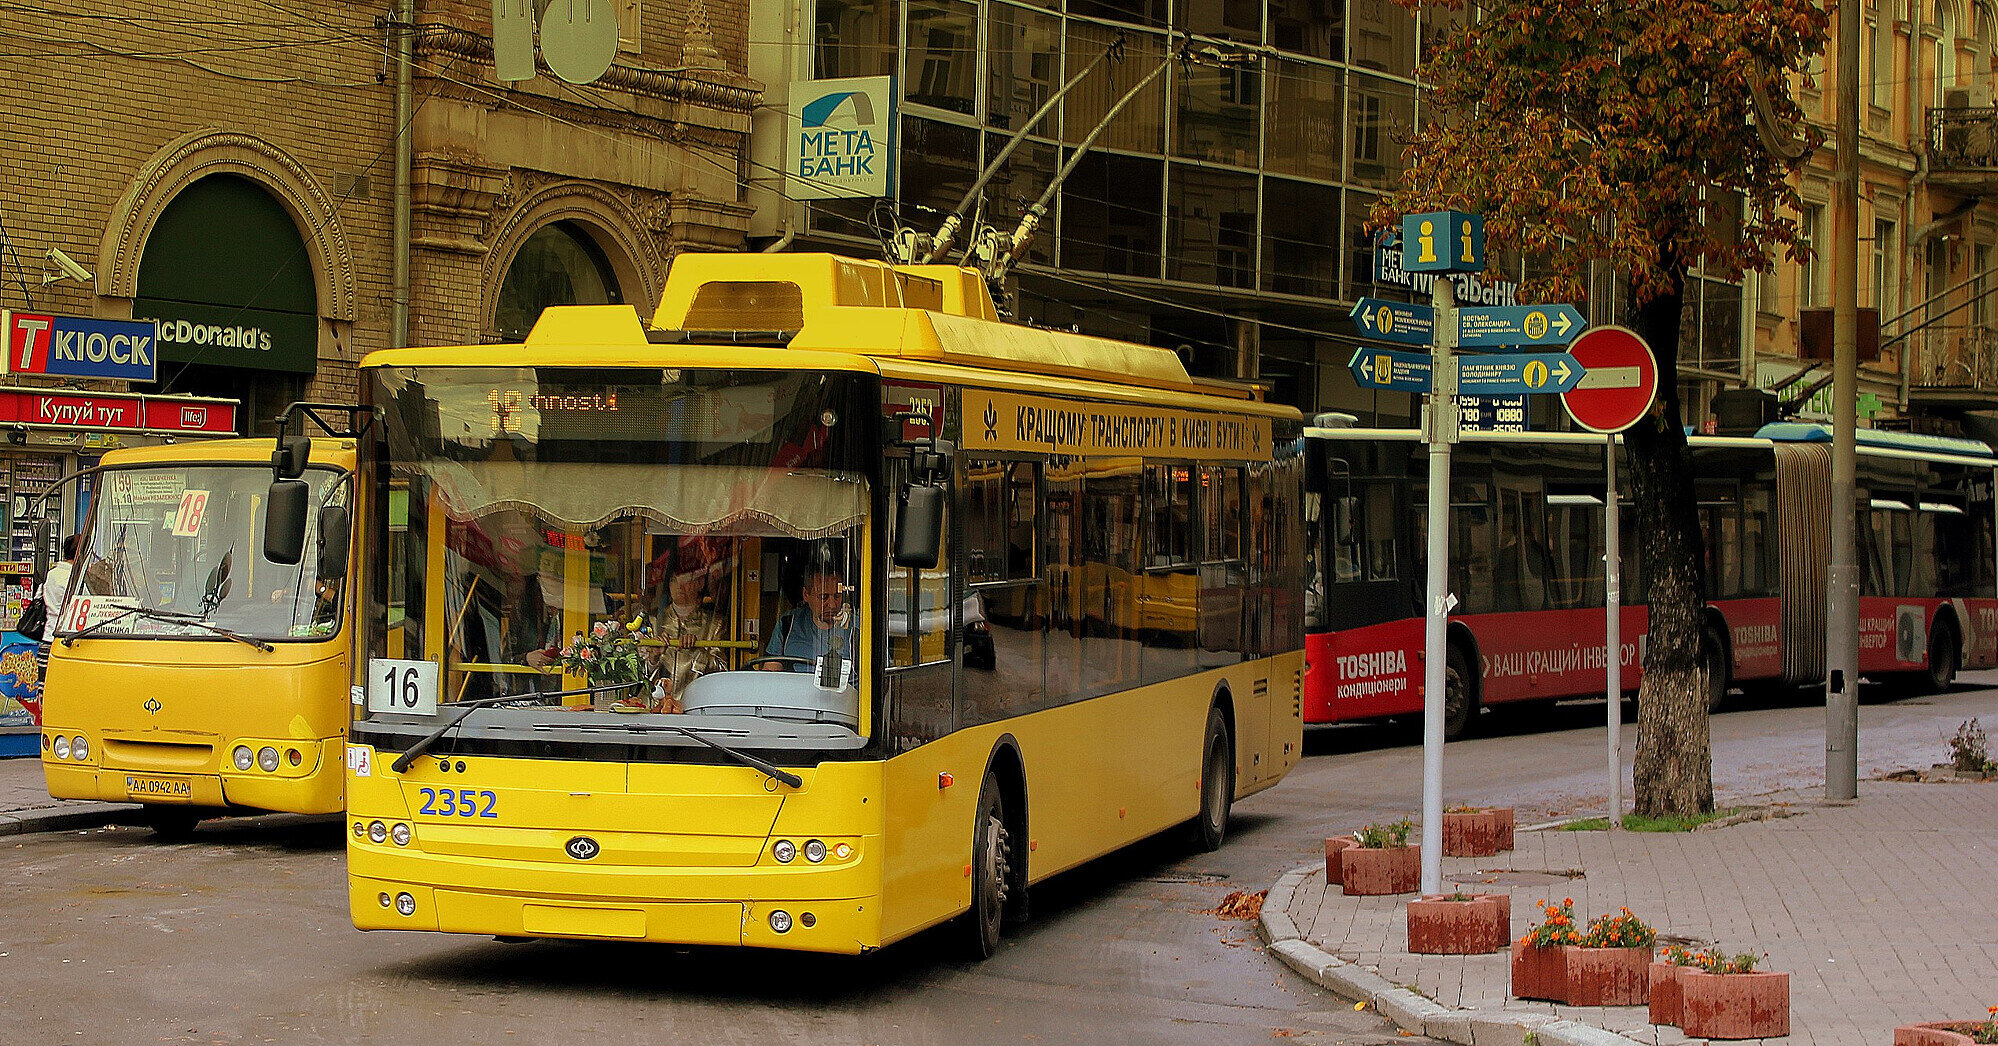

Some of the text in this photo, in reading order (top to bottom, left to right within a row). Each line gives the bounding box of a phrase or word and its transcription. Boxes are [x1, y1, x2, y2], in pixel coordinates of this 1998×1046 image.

[800, 130, 875, 157] МЕТА
[800, 155, 874, 177] БАНК
[1382, 248, 1403, 269] МЕТ
[1381, 266, 1411, 286] БАНК
[40, 398, 124, 427] Купуй тут
[1496, 408, 1523, 422] 10880
[1016, 404, 1086, 450] КРАЩОМУ
[1090, 413, 1165, 448] ТРАНСПОРТУ
[1170, 417, 1176, 446] В
[1182, 418, 1211, 450] КИЄВІ
[180, 493, 205, 533] 18
[67, 599, 91, 632] 18
[1734, 625, 1778, 645] TOSHIBA
[1336, 649, 1407, 680] TOSHIBA
[1494, 651, 1523, 677] ВАШ
[1526, 642, 1581, 676] КРАЩИЙ
[384, 666, 420, 708] 16
[1337, 675, 1407, 700] кондиціонери
[133, 779, 188, 794] AA 0942 AA
[419, 787, 498, 818] 2352
